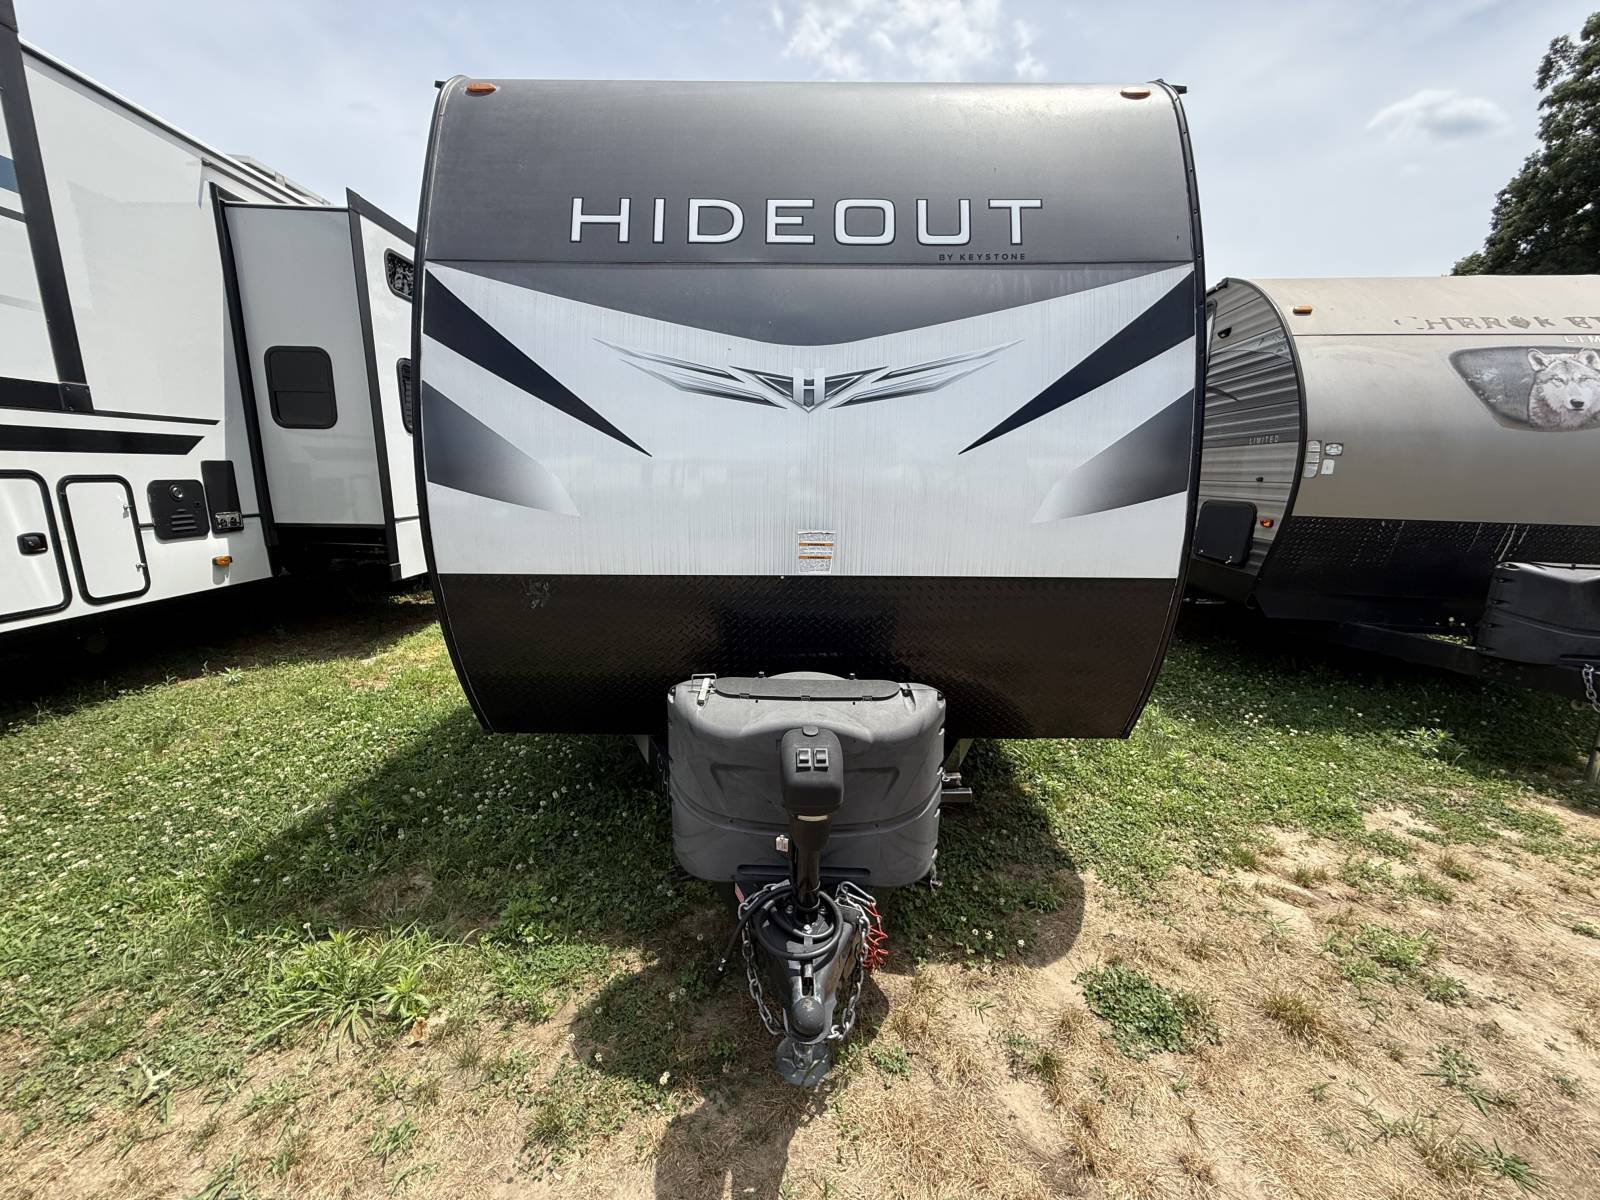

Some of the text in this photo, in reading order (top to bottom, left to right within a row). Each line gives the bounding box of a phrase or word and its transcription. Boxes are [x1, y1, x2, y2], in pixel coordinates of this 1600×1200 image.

[569, 197, 1043, 246] HIDEOUT
[938, 253, 1025, 261] BY KEYSTONE
[1249, 434, 1279, 445] LIMITED
